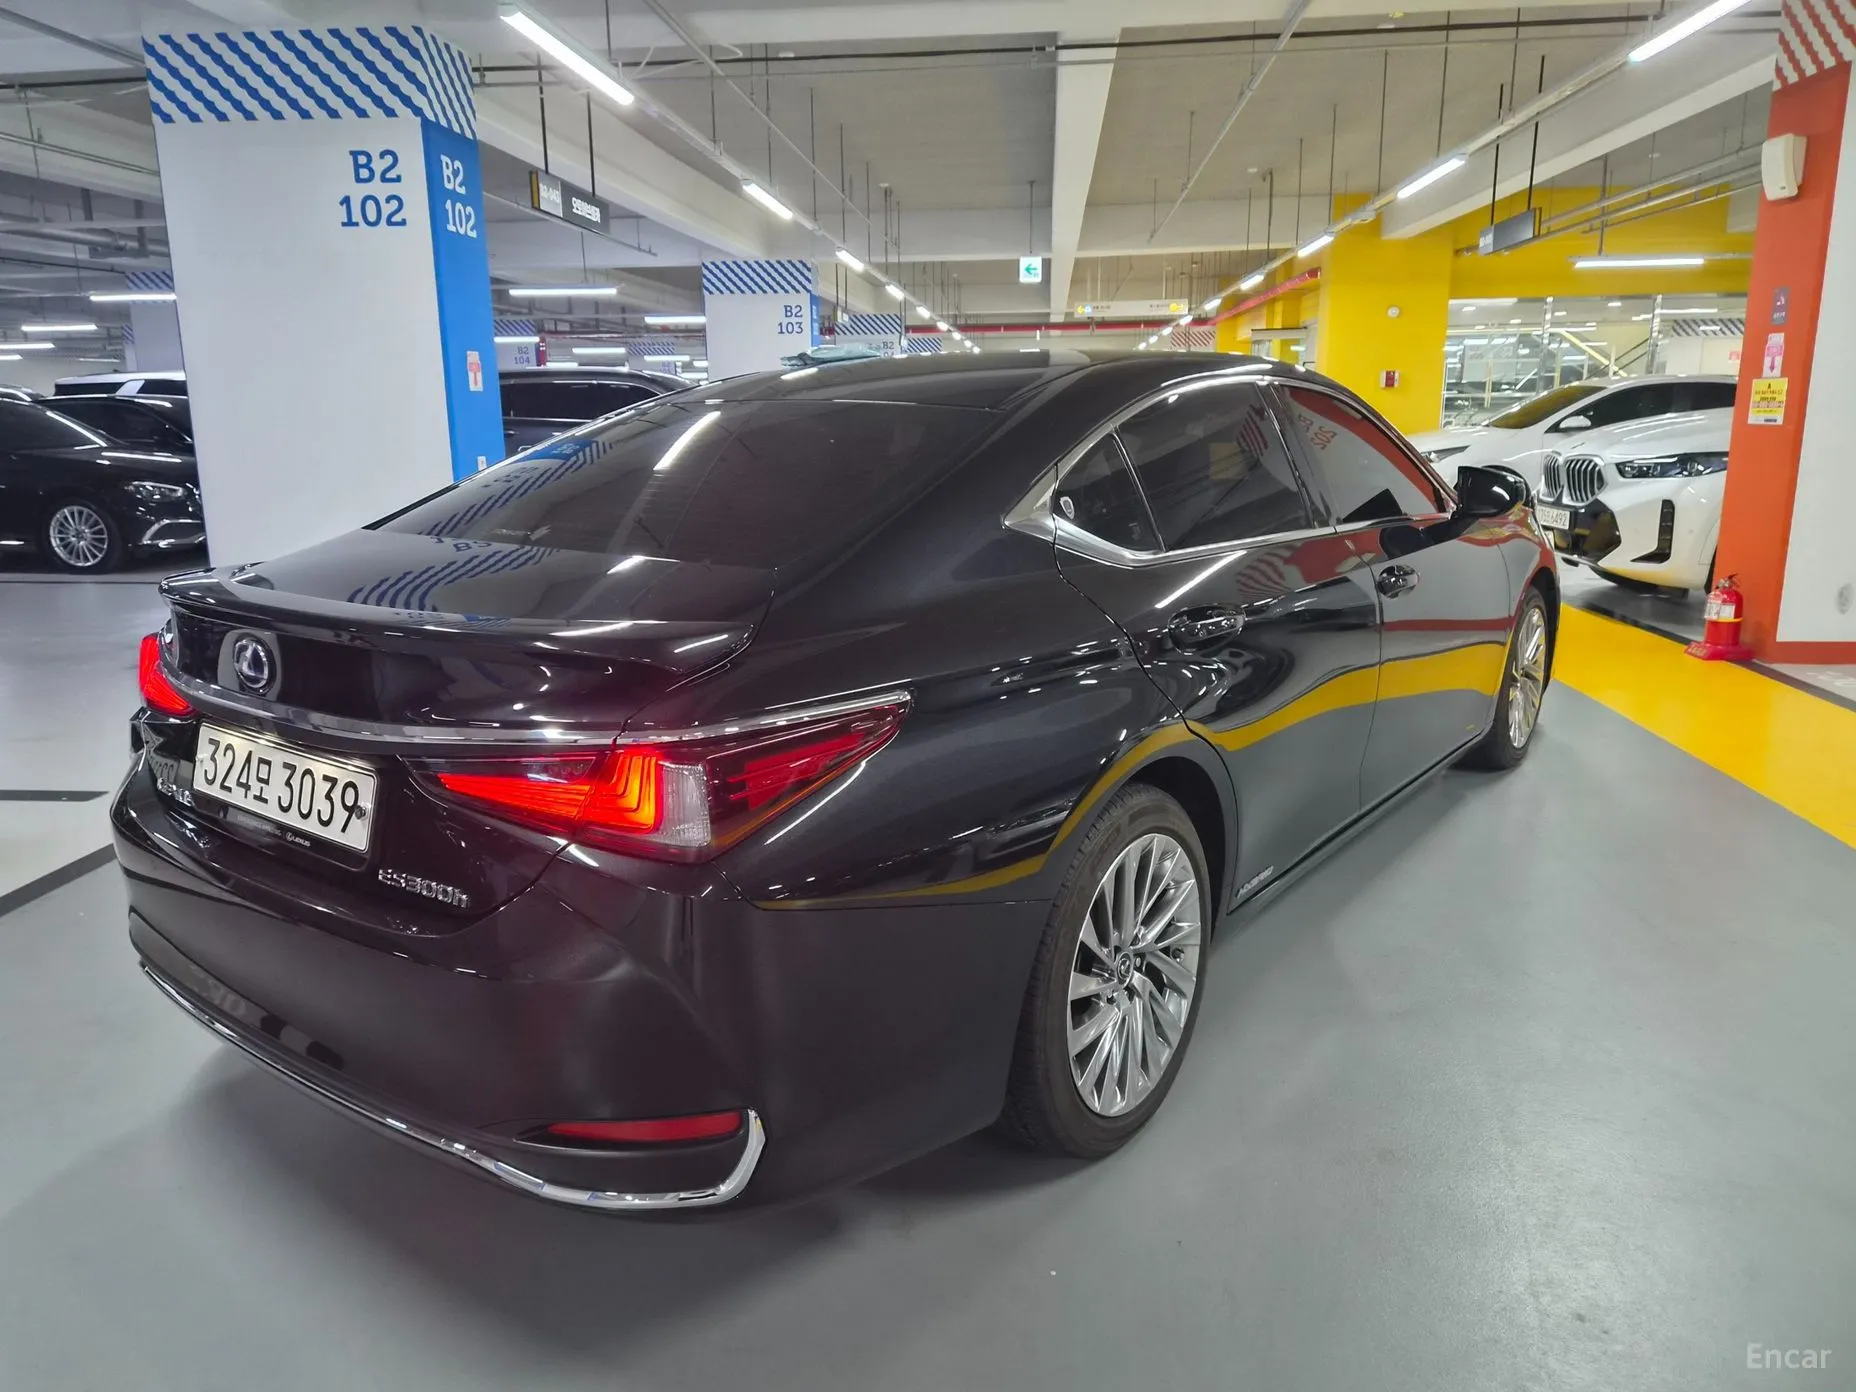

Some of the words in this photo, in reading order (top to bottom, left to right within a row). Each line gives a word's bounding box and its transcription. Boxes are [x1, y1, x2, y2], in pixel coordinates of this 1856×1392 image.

[348, 149, 402, 184] B2
[440, 153, 466, 195] B2
[338, 194, 407, 227] 102
[445, 199, 477, 239] 102
[777, 321, 804, 335] 103
[783, 304, 804, 318] B2
[513, 356, 531, 365] 104
[203, 737, 273, 805] 324모
[277, 761, 361, 834] 3039
[378, 868, 470, 909] ES300h
